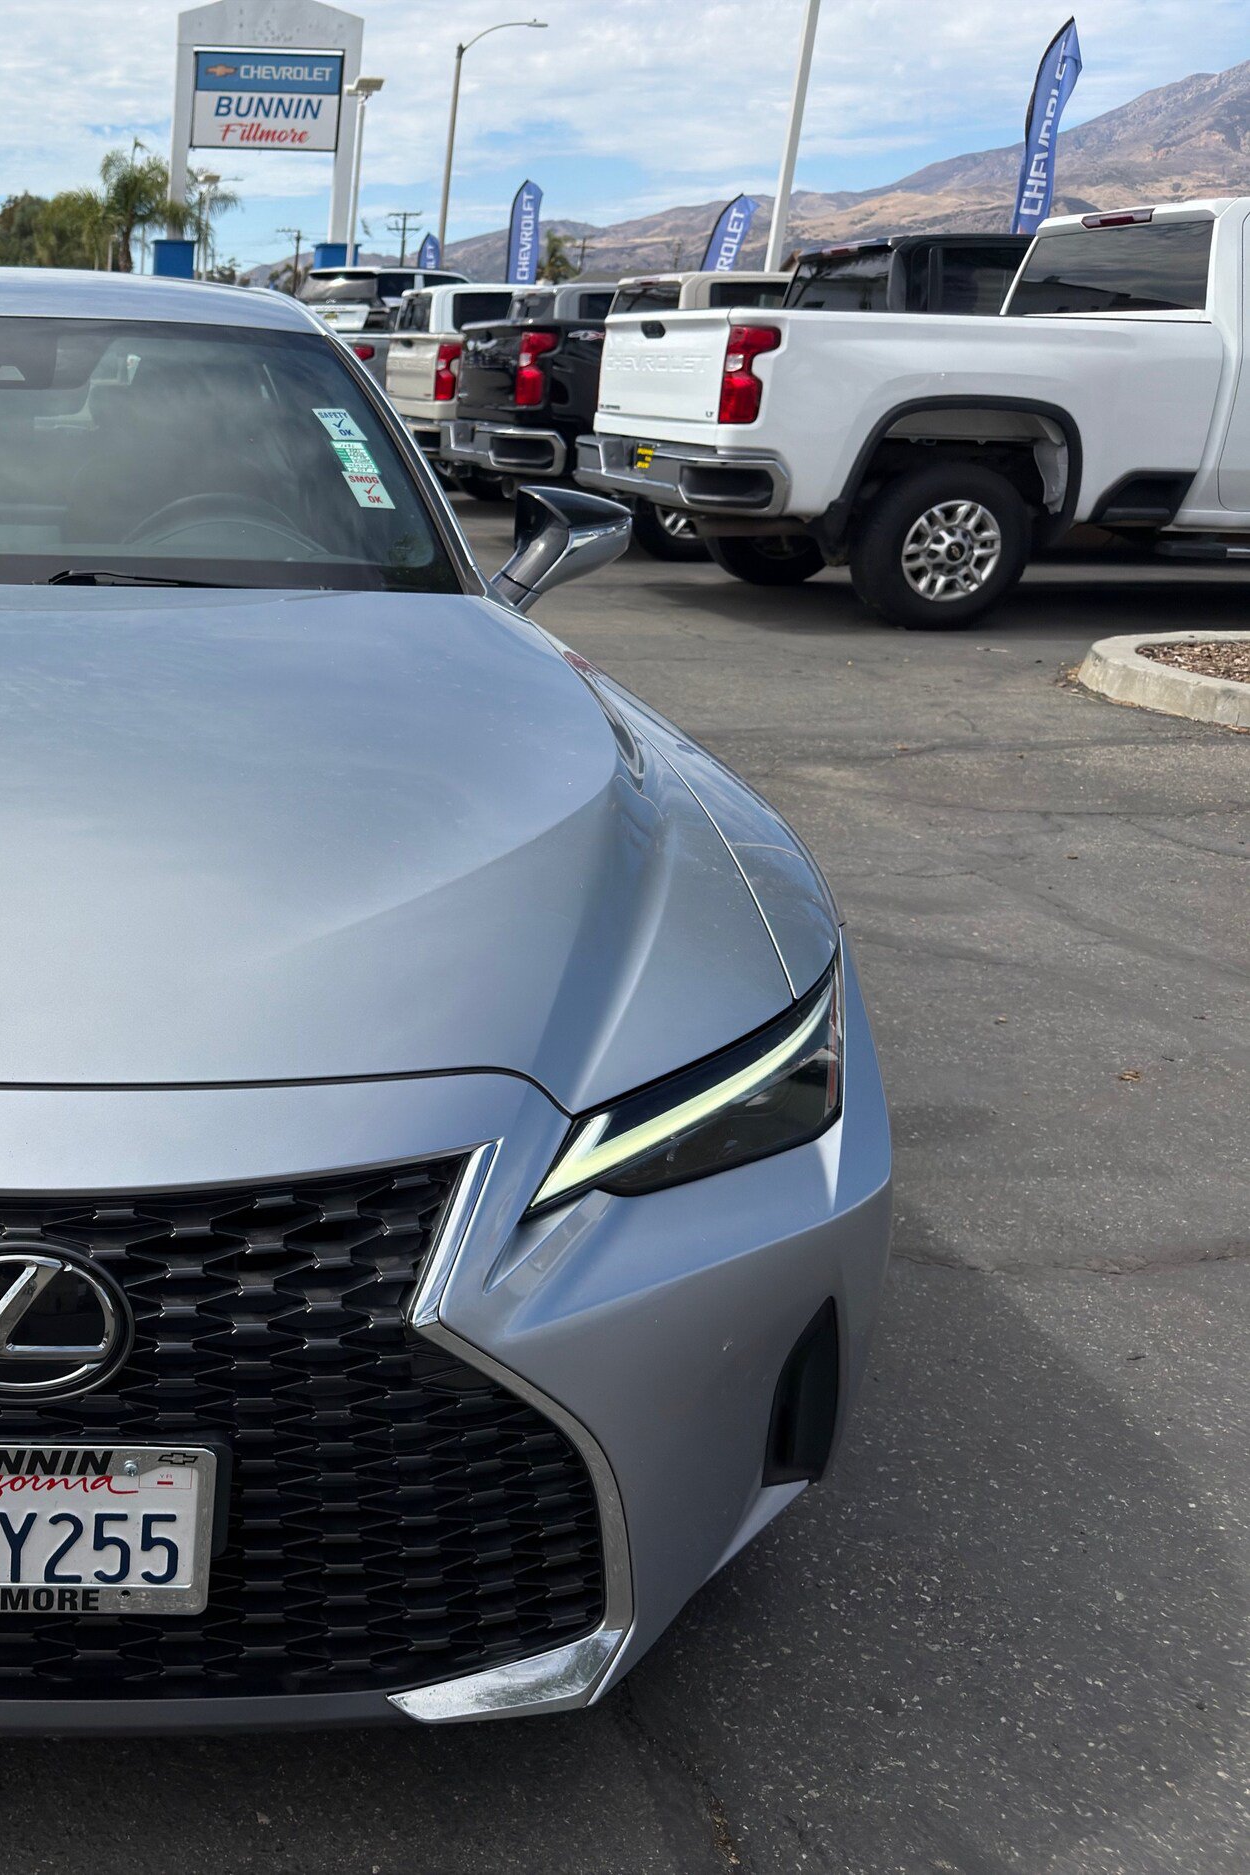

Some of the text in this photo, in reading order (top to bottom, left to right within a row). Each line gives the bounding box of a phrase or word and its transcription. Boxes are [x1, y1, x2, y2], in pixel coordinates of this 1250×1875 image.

[239, 64, 333, 82] CHEVROLET
[214, 95, 322, 120] BUNNIN
[219, 122, 310, 144] Fillmore
[516, 190, 535, 281] CHEVROLET
[714, 207, 745, 272] ROLET
[317, 411, 349, 420] SAFETY
[338, 429, 355, 437] OK
[348, 475, 380, 485] SMOG
[367, 495, 384, 504] OK
